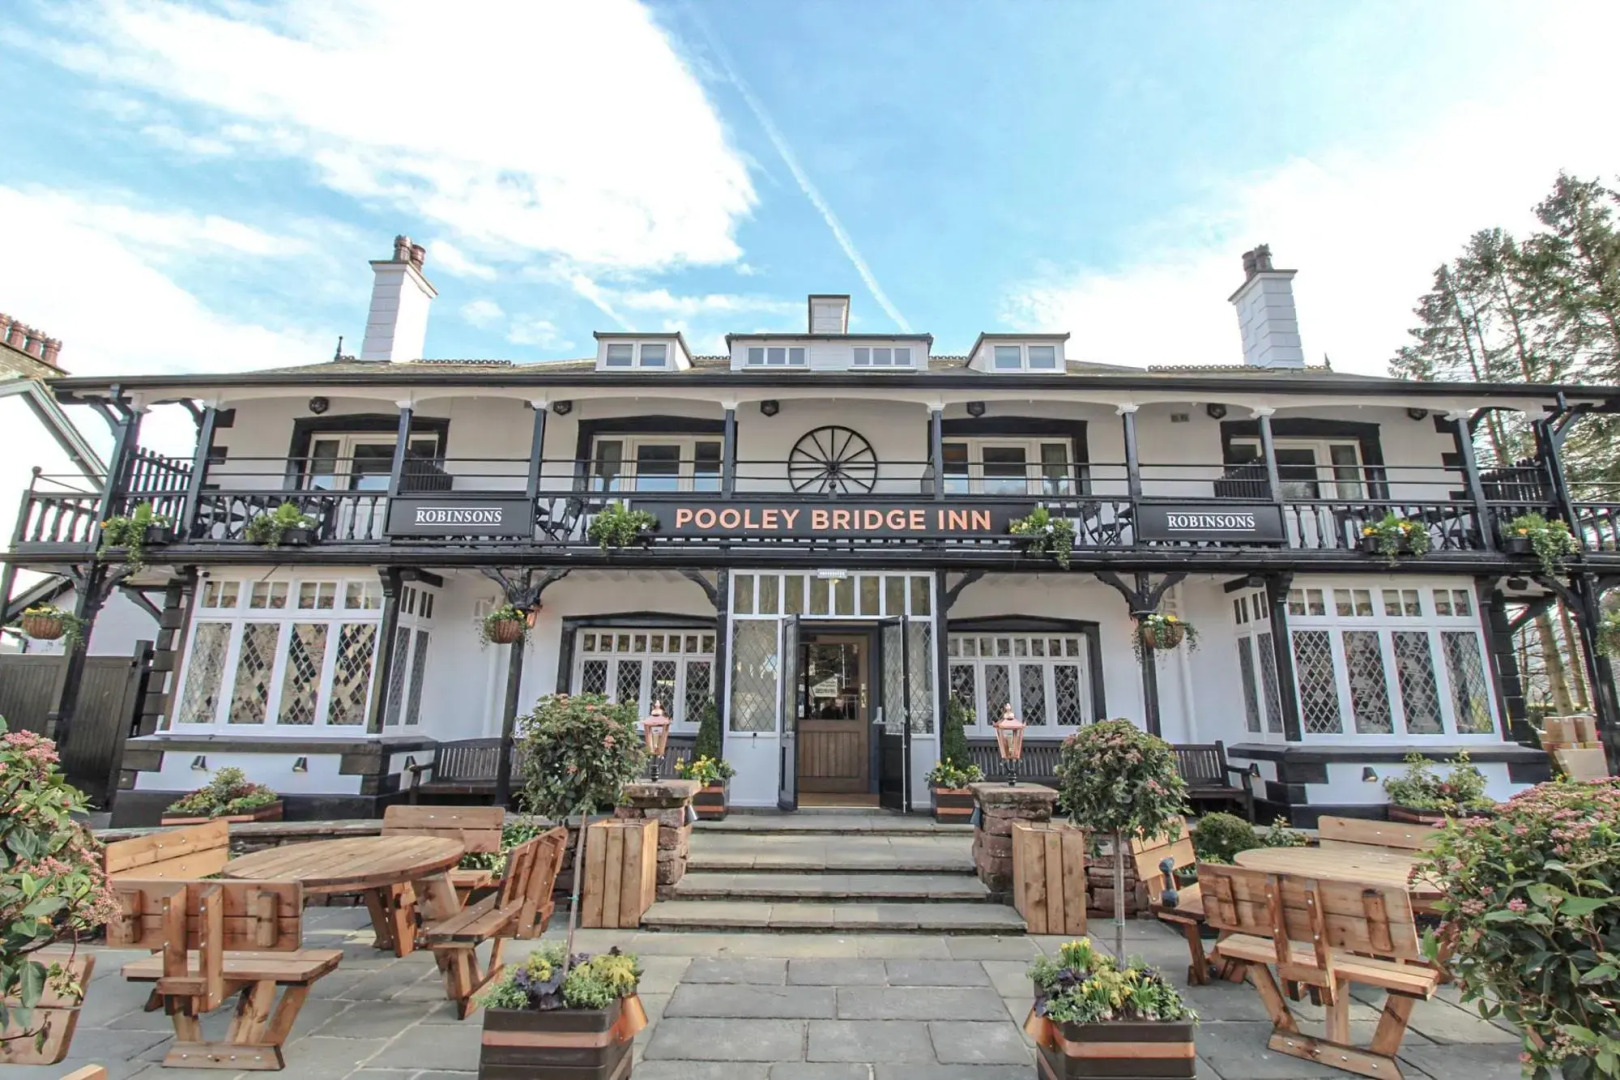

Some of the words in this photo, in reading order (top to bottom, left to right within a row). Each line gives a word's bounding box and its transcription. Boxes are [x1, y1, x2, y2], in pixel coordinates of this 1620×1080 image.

[415, 510, 502, 522] ROBINSONS
[675, 509, 800, 529] POOLEY
[811, 510, 926, 530] BRIDGE
[938, 510, 991, 530] INN
[1167, 515, 1255, 528] ROBINSONS
